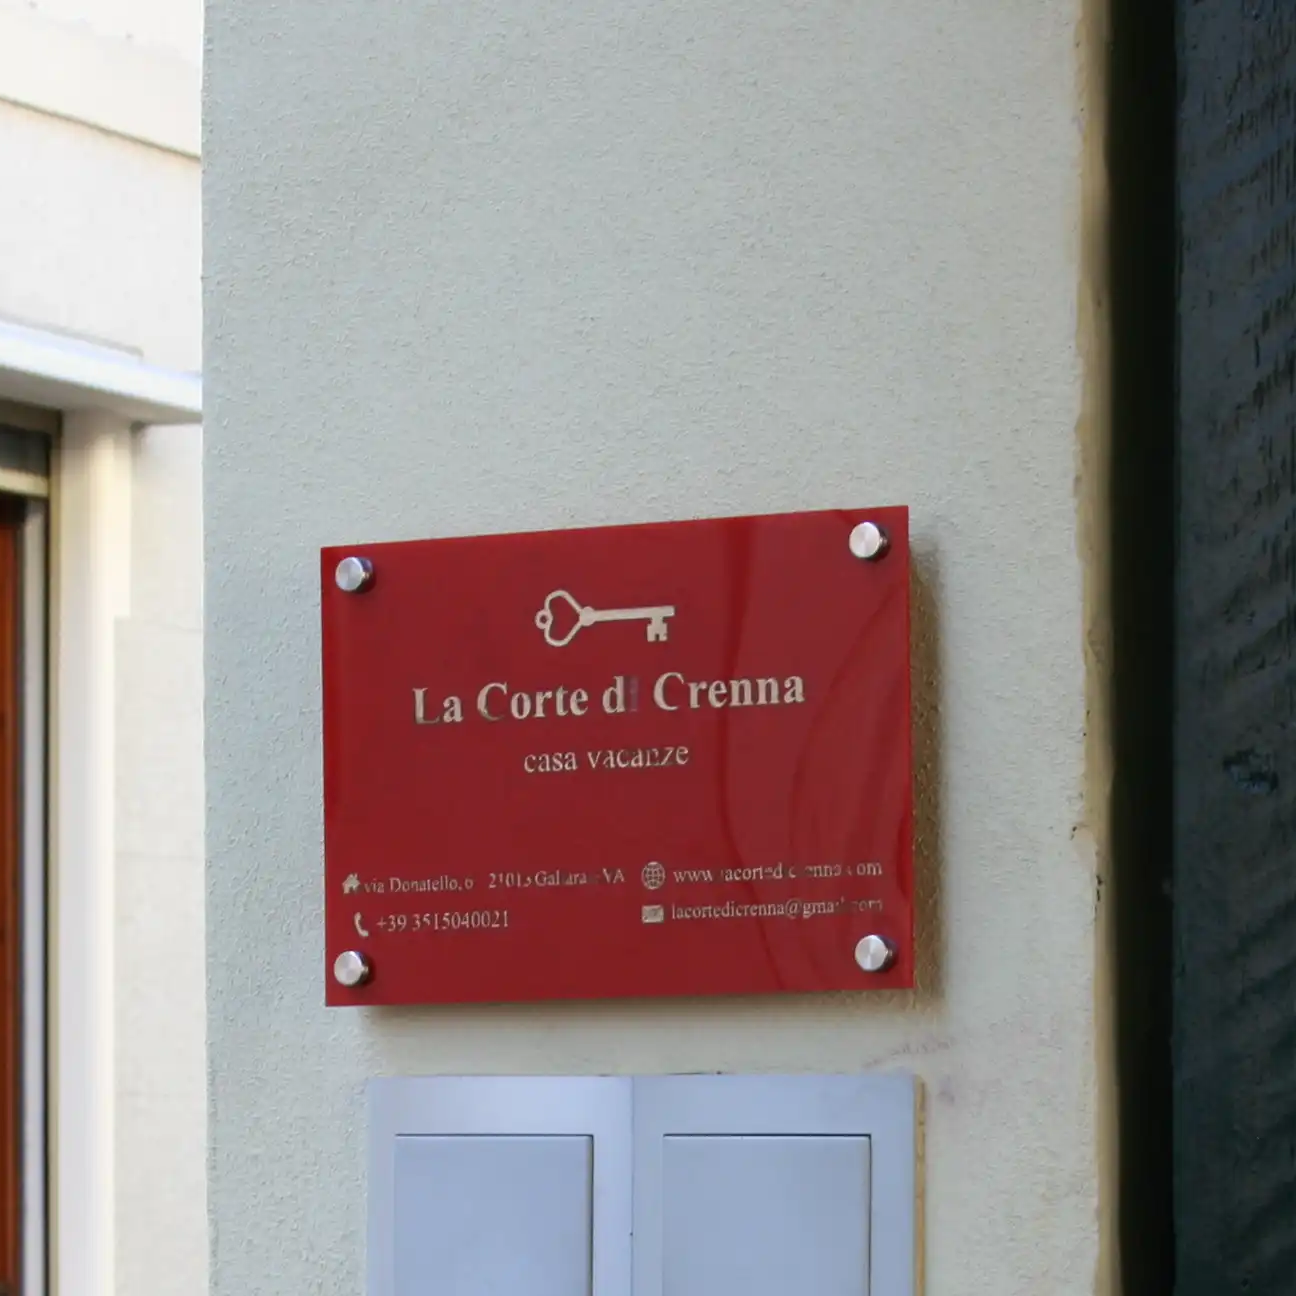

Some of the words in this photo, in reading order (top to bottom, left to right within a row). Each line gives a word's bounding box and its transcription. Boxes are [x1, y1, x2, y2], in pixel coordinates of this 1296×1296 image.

[412, 687, 464, 725] La
[477, 681, 589, 722] Corte
[653, 671, 806, 713] Crenna
[524, 750, 578, 773] casa
[587, 744, 689, 770] vacanze
[364, 878, 385, 894] via
[376, 913, 406, 932] +39
